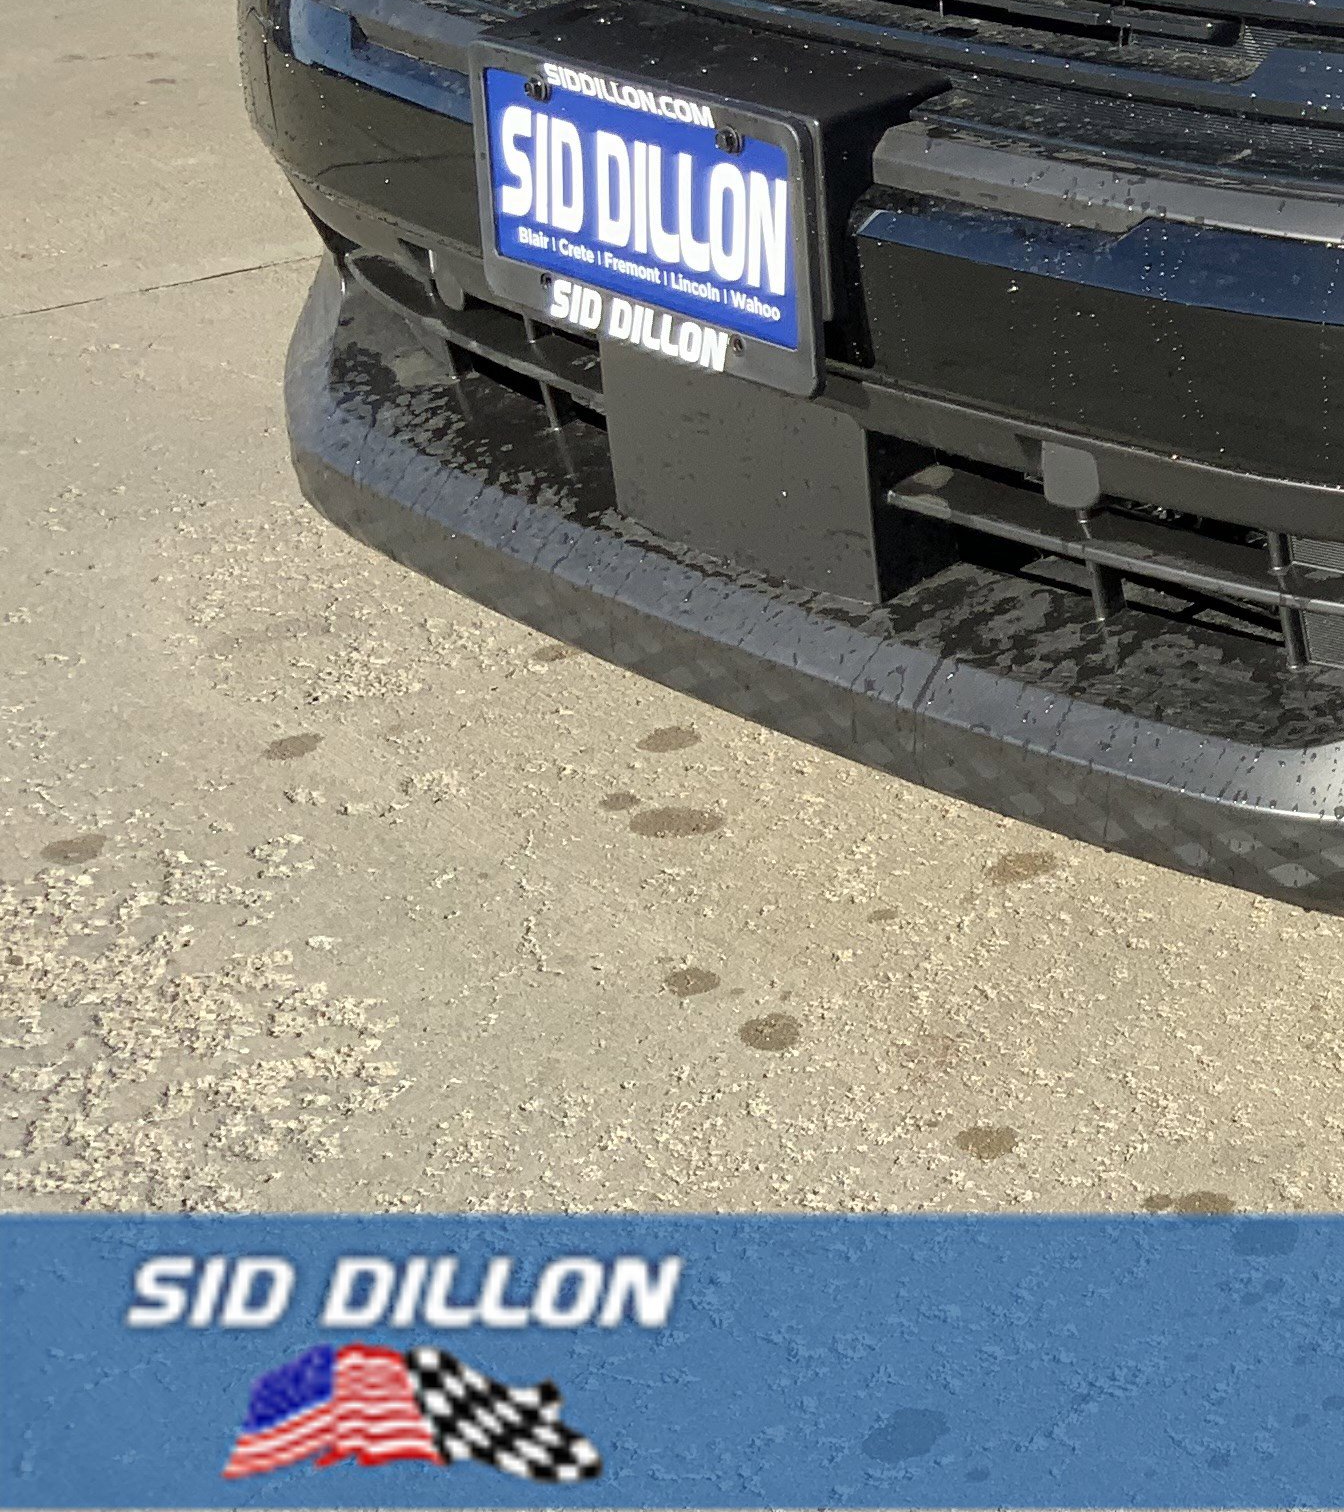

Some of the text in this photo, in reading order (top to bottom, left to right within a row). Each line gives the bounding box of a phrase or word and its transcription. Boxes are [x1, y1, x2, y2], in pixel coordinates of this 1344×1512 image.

[542, 62, 716, 130] SIDDILLON.COM
[501, 105, 788, 296] SID DILLON
[518, 226, 782, 323] Blair Crete Fremont Lincoln Wahoo
[549, 278, 729, 373] SID DILLON
